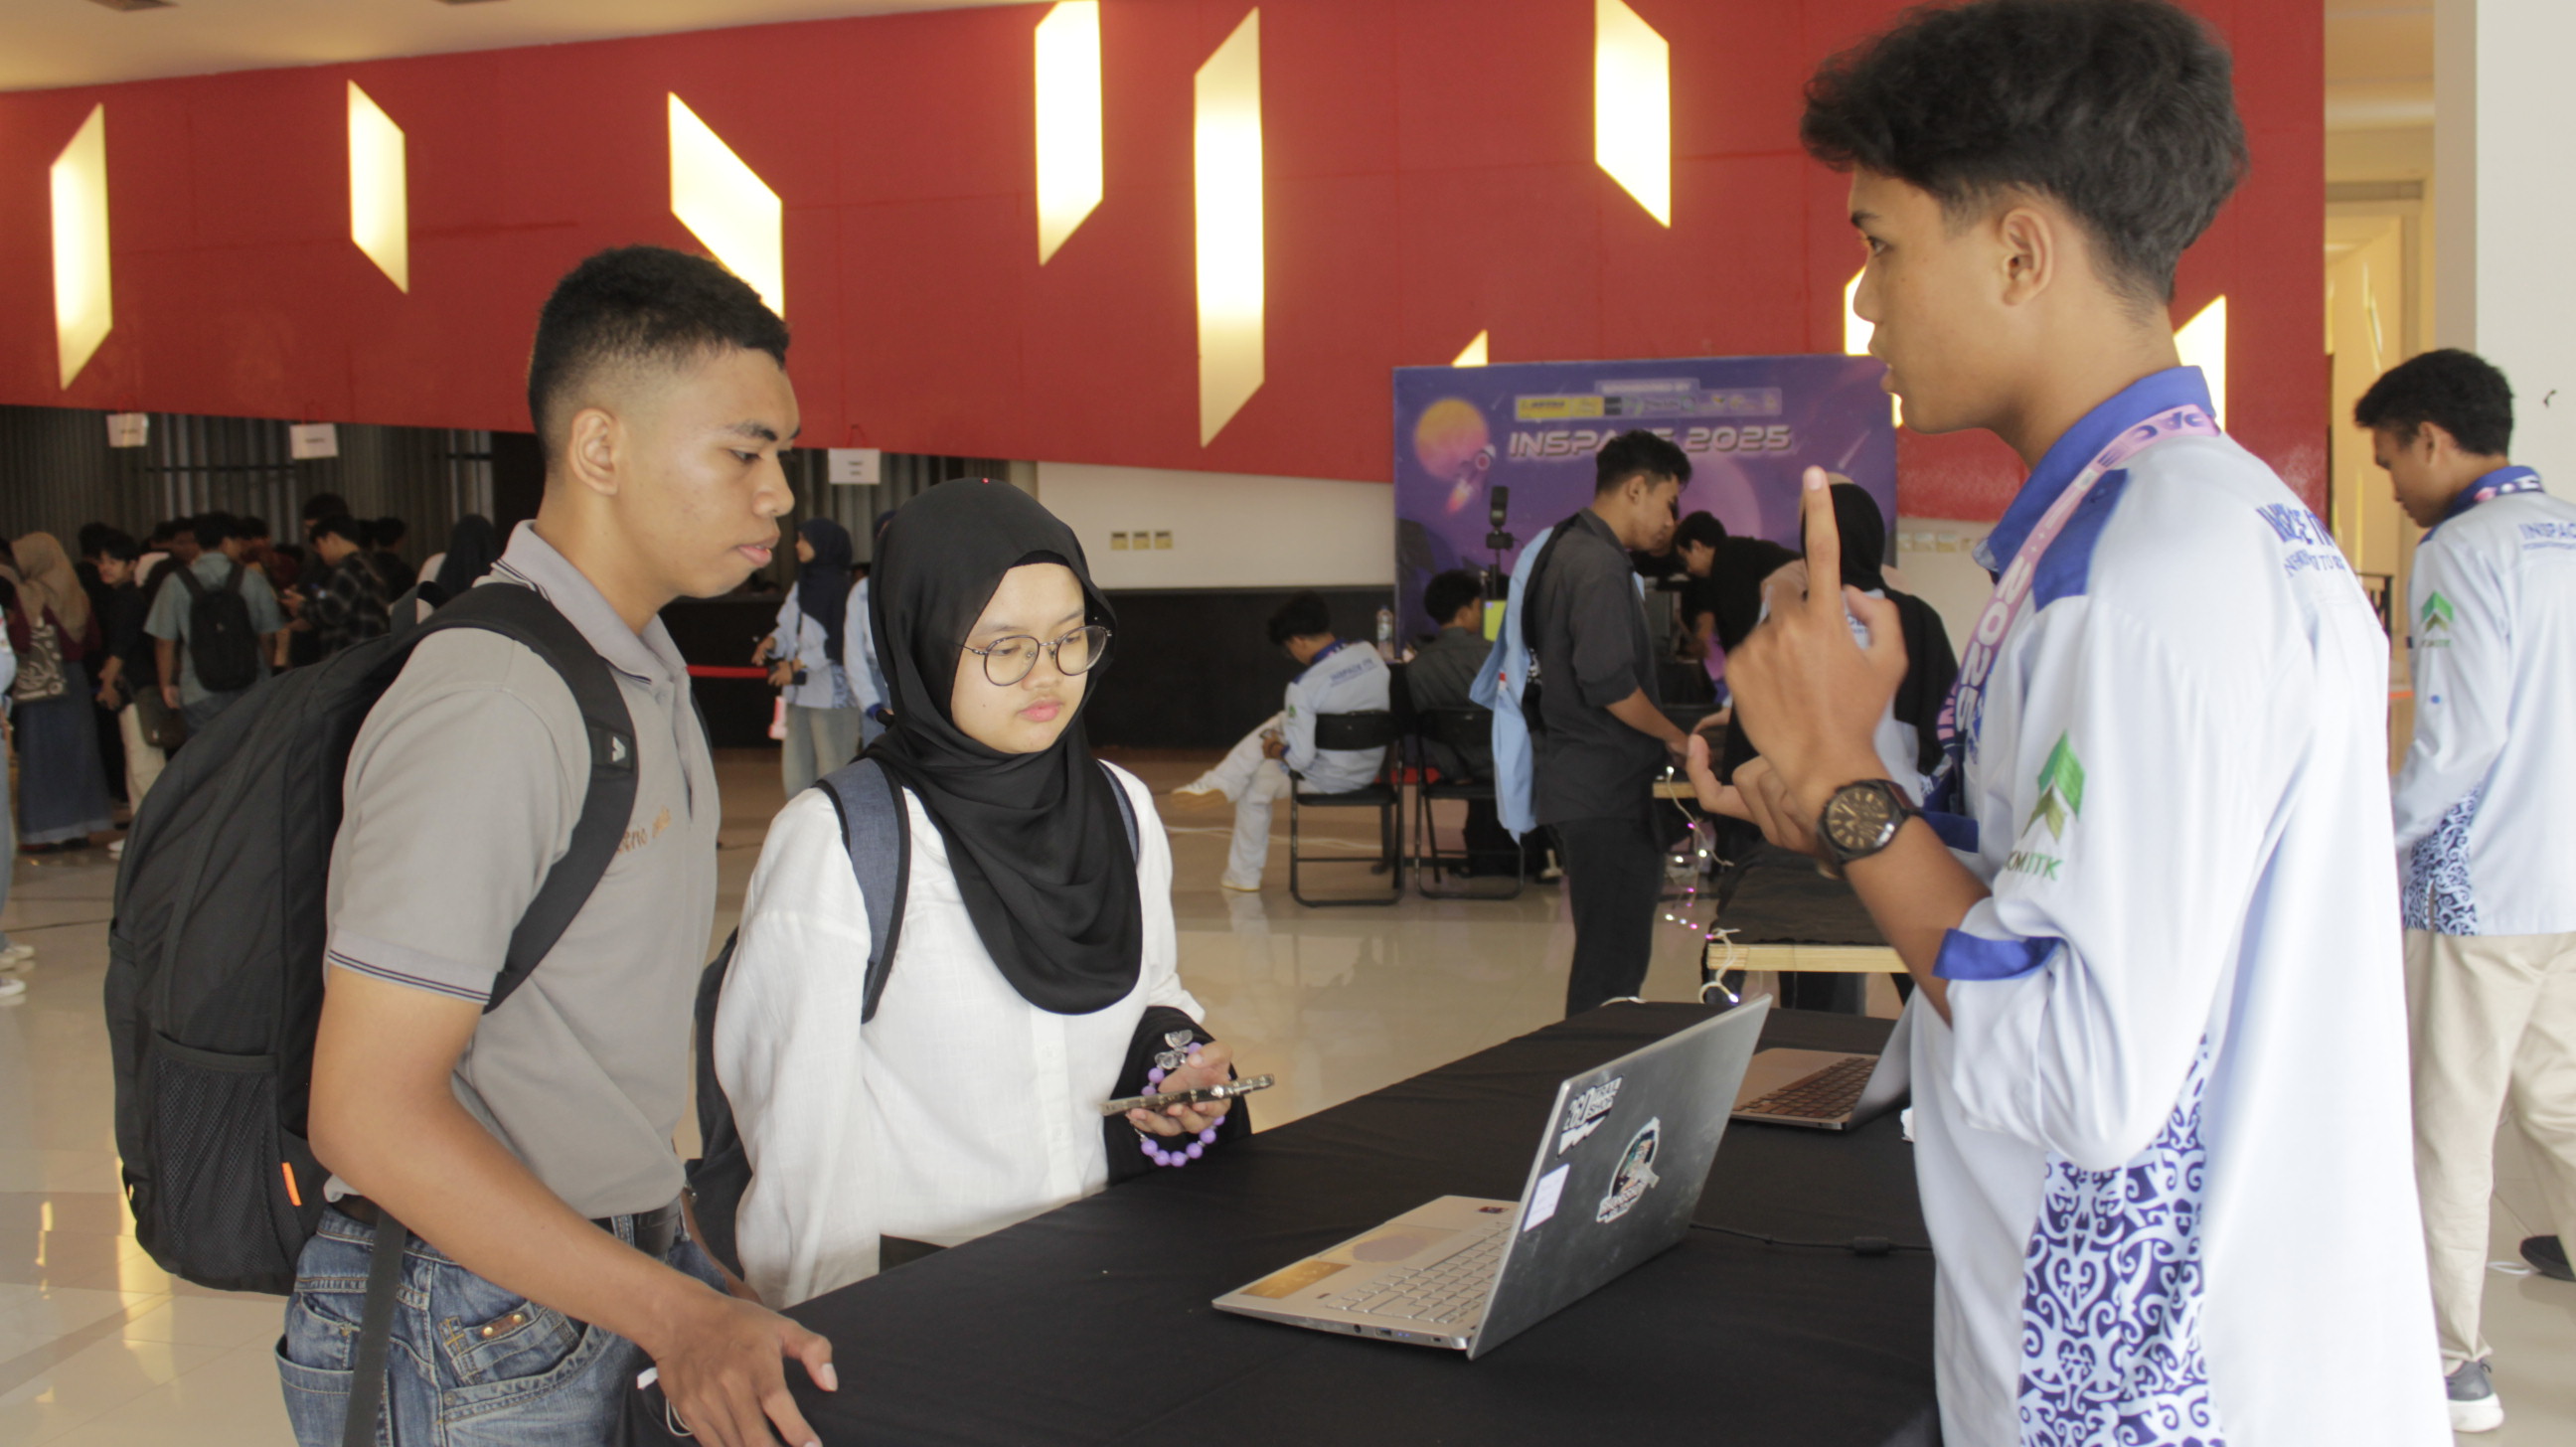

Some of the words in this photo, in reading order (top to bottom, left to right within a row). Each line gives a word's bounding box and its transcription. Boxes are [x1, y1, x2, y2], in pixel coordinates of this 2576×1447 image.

[1509, 427, 1675, 457] INSPA
[1685, 425, 1792, 453] 2025
[1955, 555, 2033, 733] 2025
